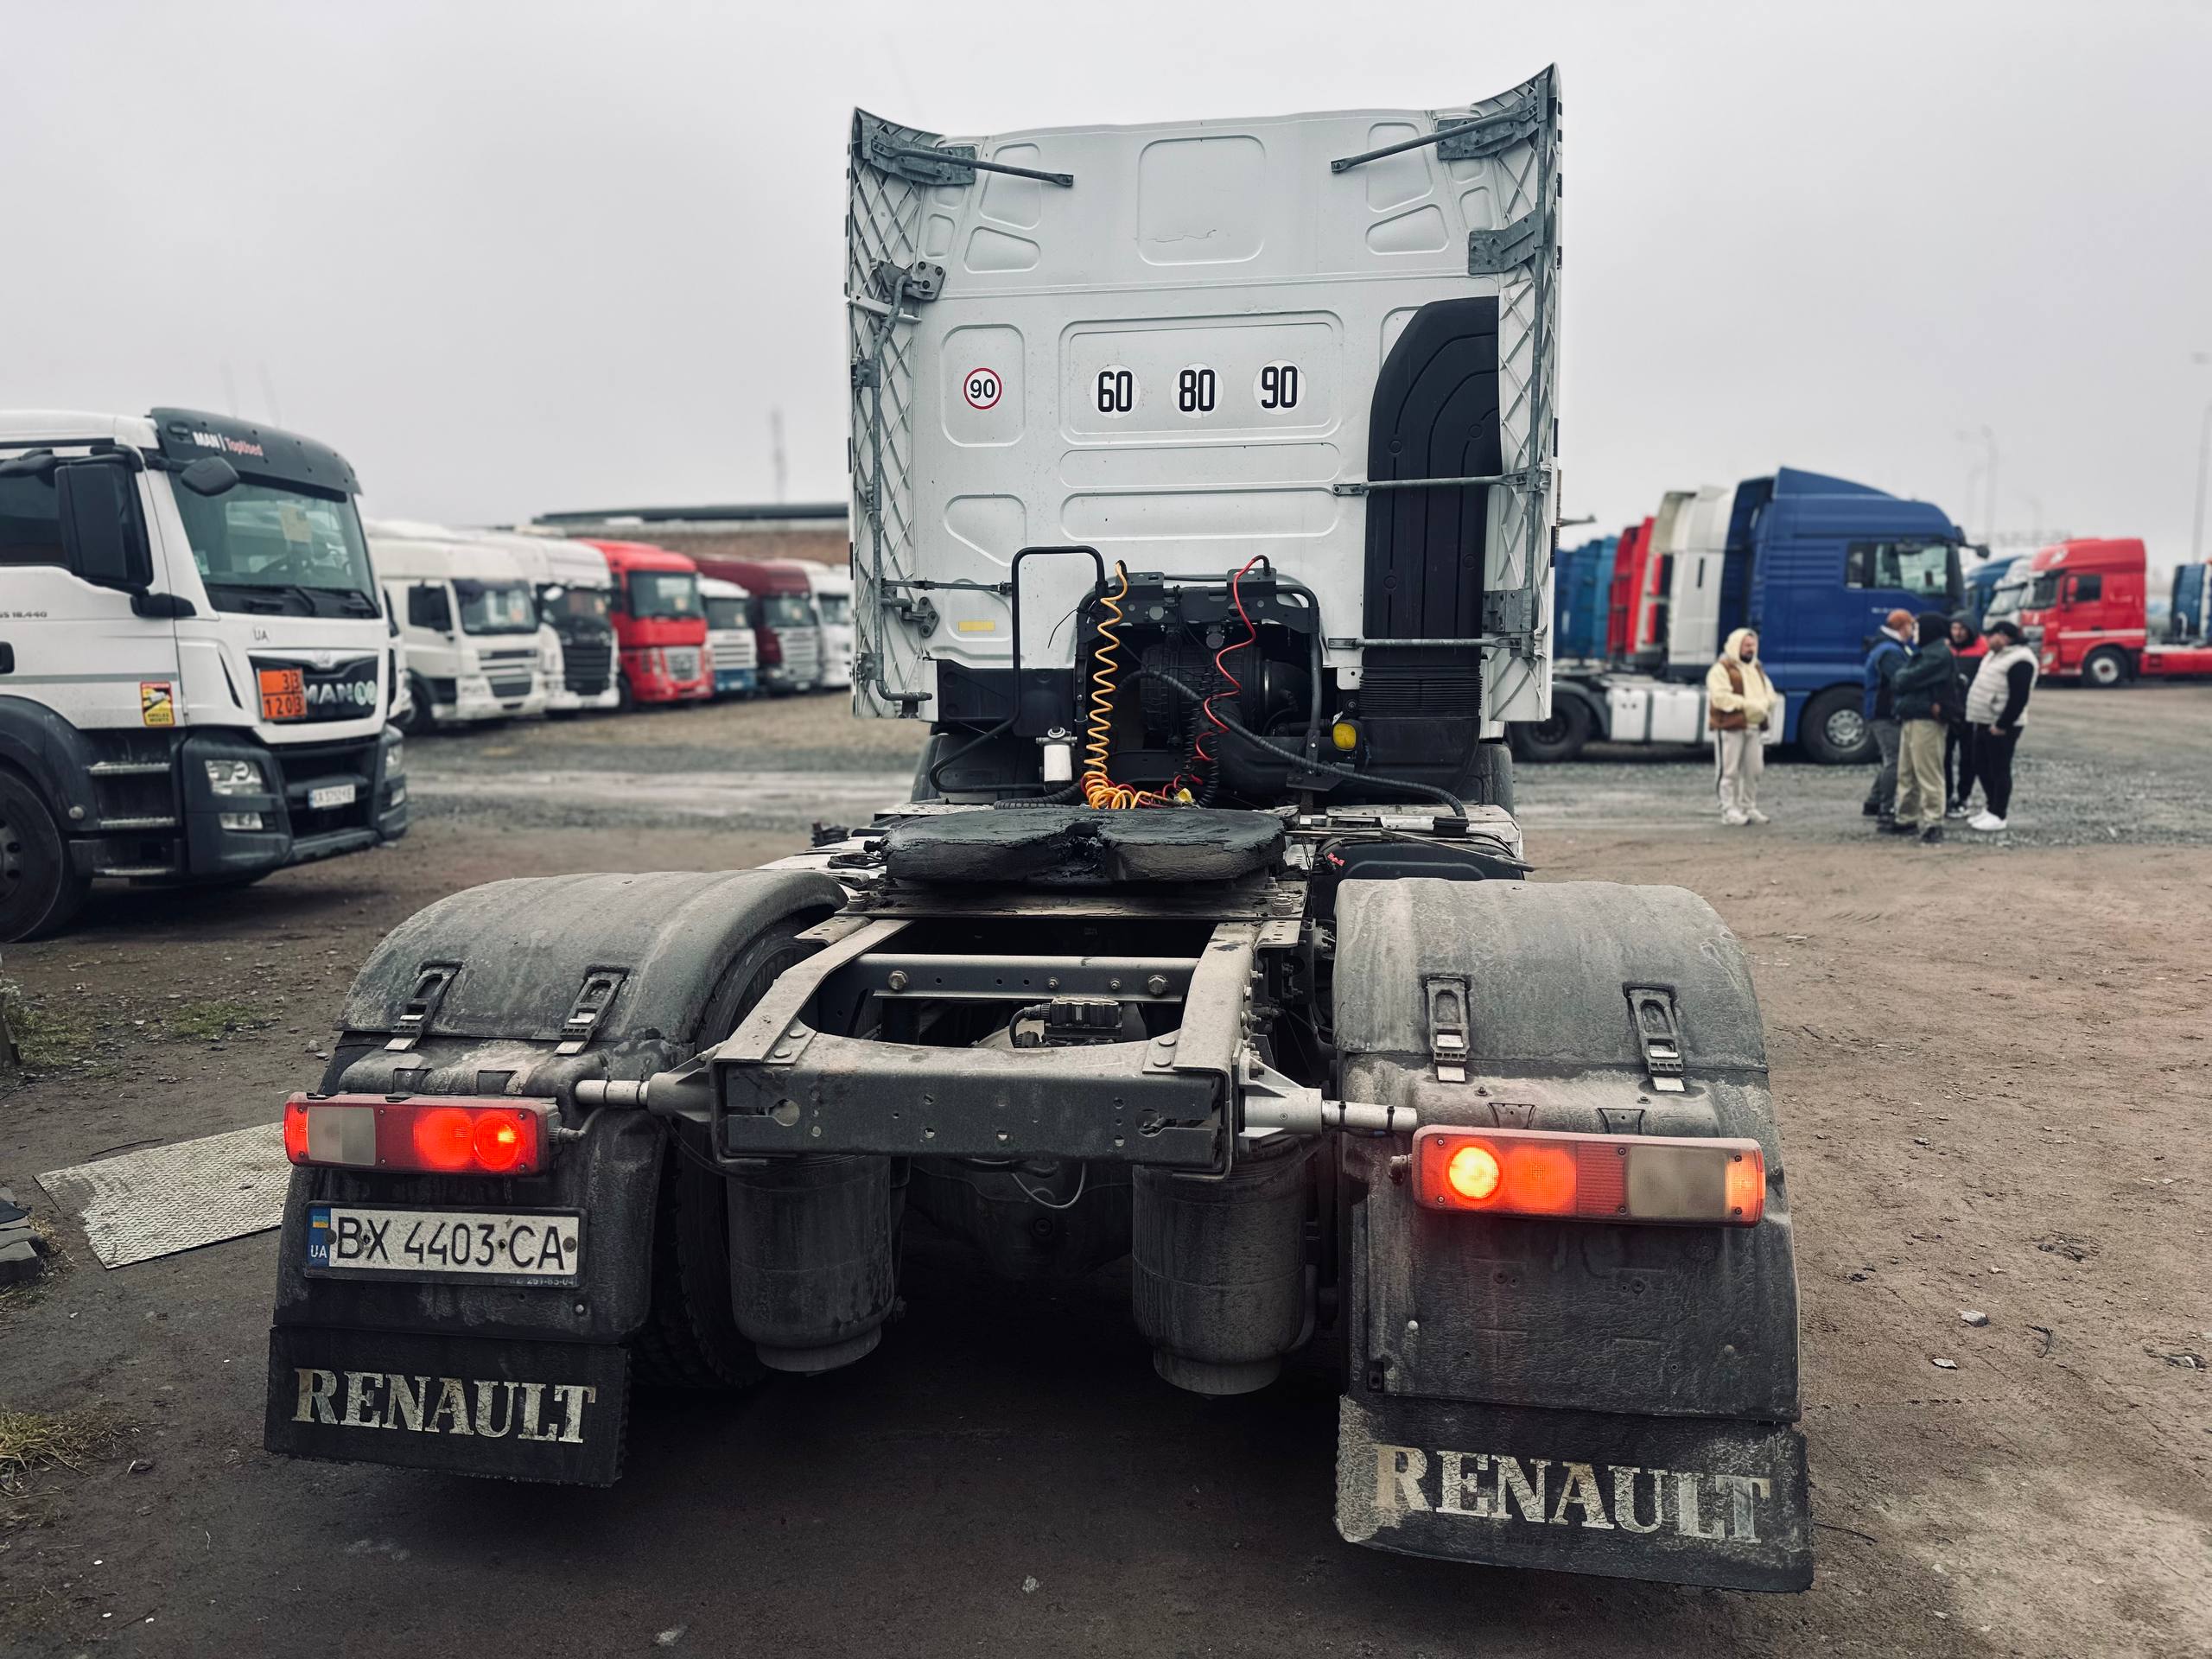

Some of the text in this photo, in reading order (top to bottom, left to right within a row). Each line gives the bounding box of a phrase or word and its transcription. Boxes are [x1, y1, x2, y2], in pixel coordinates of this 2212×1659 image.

[969, 378, 995, 399] 90
[1097, 366, 1298, 413] 60 80 90
[192, 431, 221, 448] MAN
[253, 629, 270, 642] UA
[282, 672, 301, 690] 33
[302, 683, 354, 705] MAN
[264, 696, 303, 716] 1203
[310, 1217, 565, 1271] UA BX 4403 CA
[291, 1367, 597, 1444] RENAULT
[1371, 1443, 1770, 1544] RENAULT
